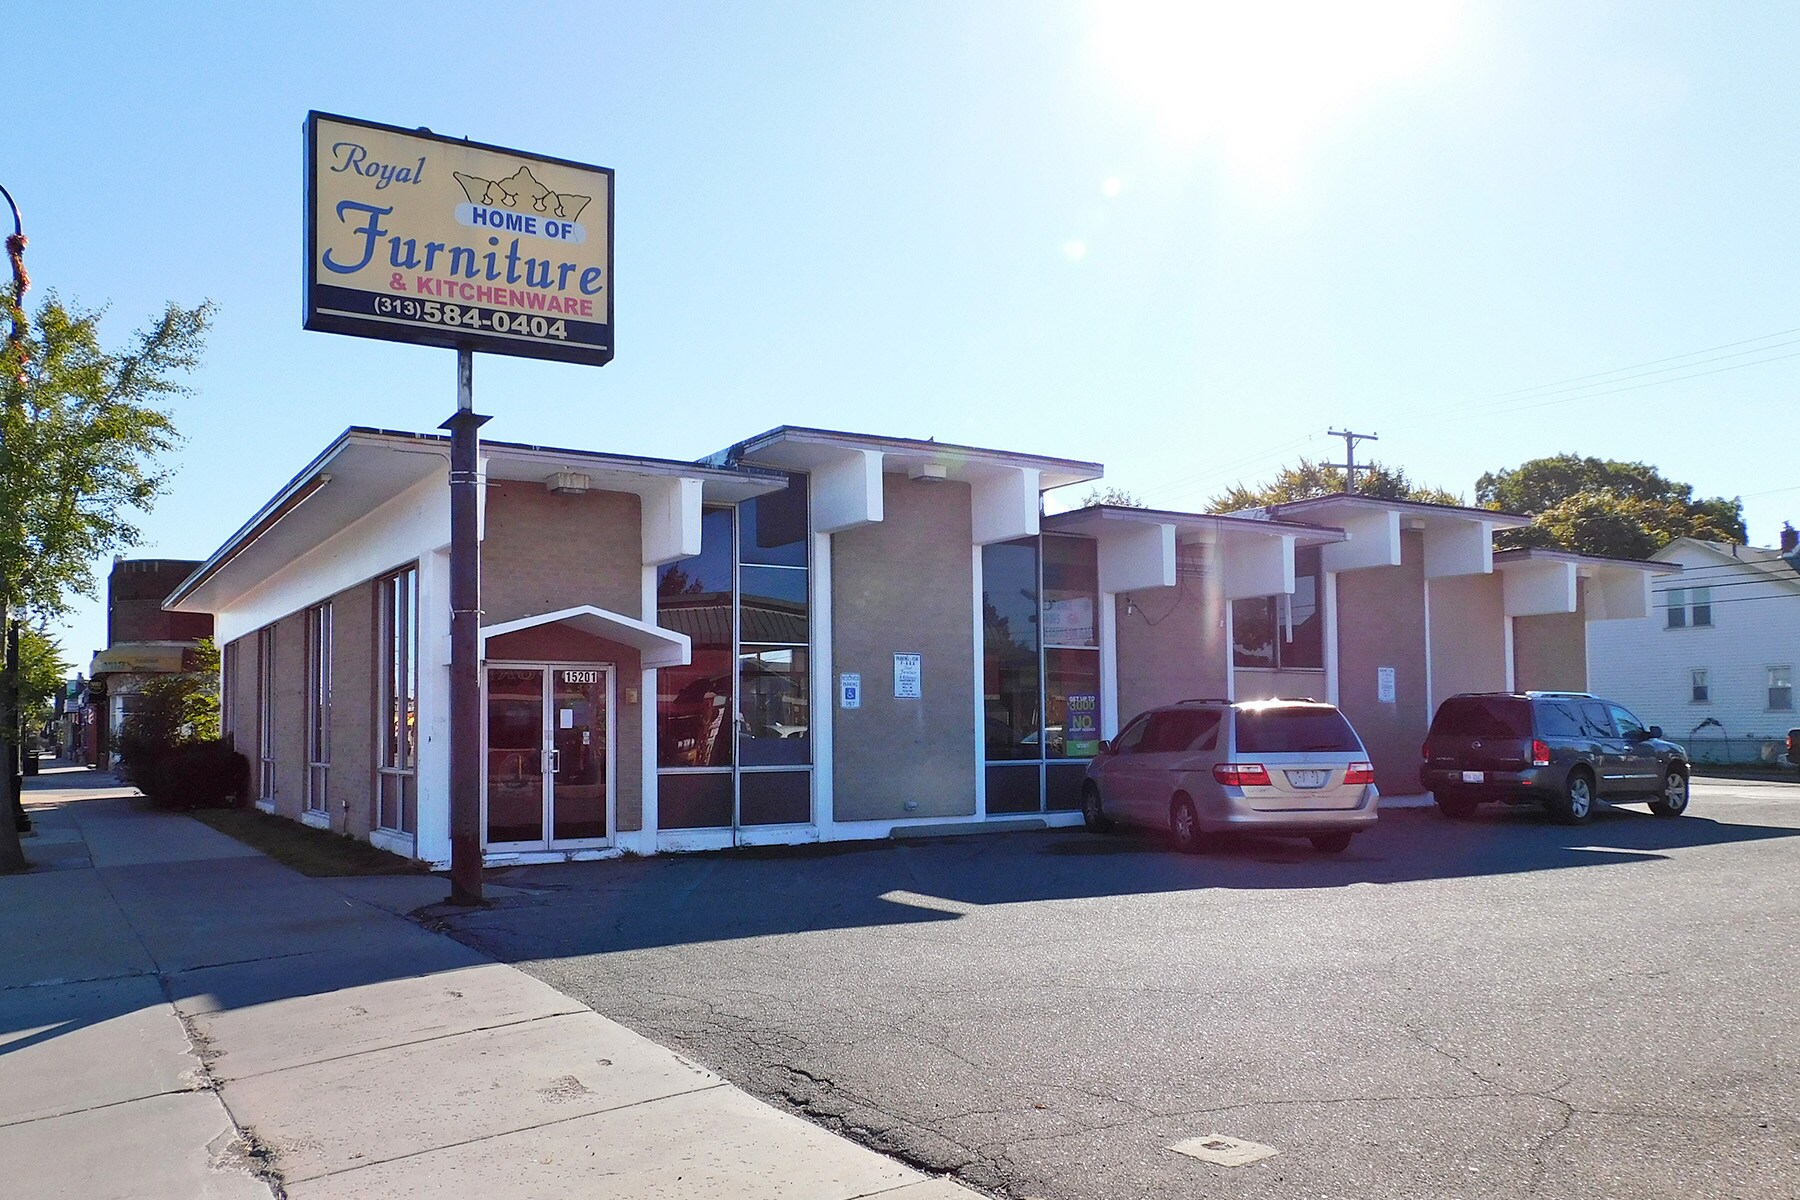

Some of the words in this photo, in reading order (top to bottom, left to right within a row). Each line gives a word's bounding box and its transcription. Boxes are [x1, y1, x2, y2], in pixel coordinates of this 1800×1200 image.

[330, 142, 426, 190] Royal
[472, 206, 536, 235] HOME
[544, 221, 573, 240] OF
[322, 200, 603, 296] Furniture
[389, 272, 407, 291] &
[416, 276, 593, 317] KITCHENWARE
[566, 671, 596, 683] 15201
[1072, 715, 1093, 728] NO
